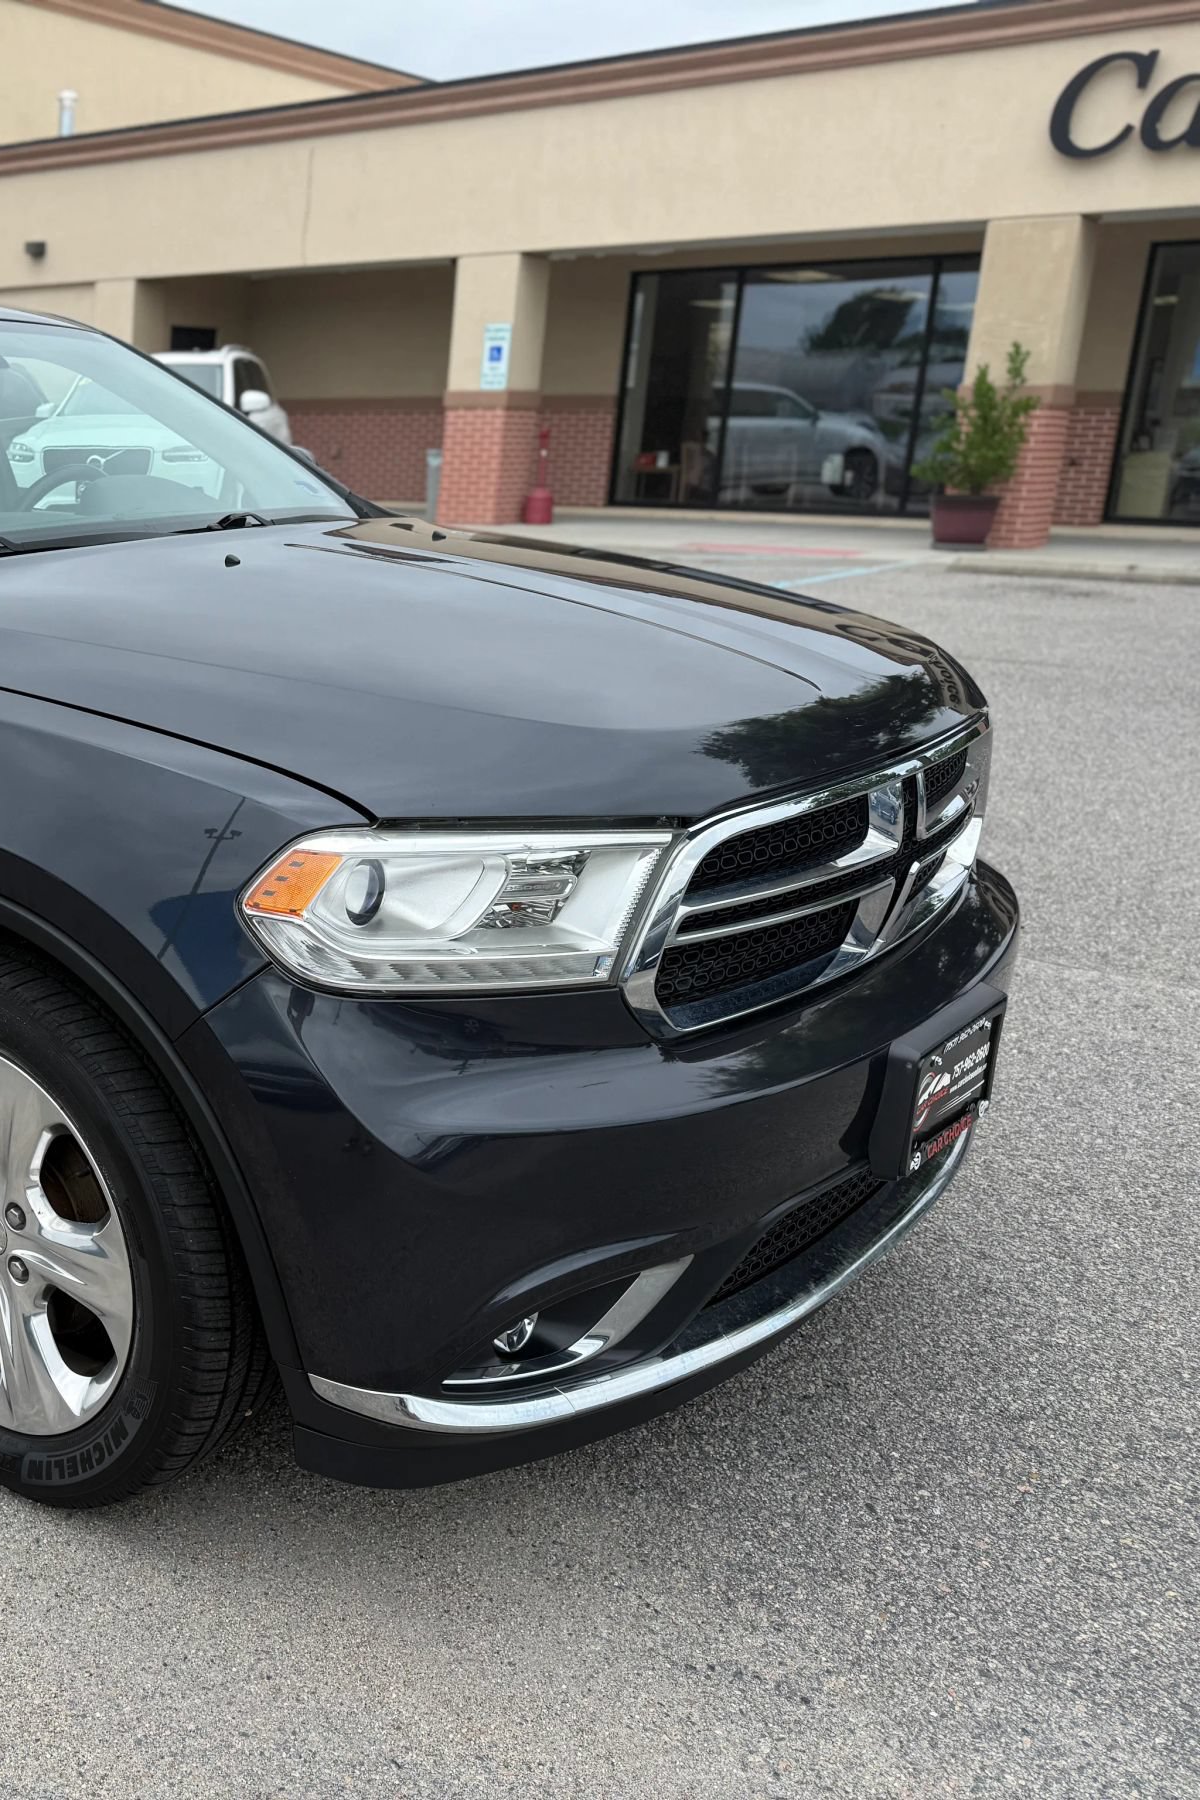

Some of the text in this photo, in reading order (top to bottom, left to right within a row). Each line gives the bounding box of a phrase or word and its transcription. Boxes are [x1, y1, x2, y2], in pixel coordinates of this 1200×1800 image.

[1050, 48, 1200, 158] Ca
[926, 1133, 944, 1159] CAR
[27, 1415, 130, 1481] MICHELIN
